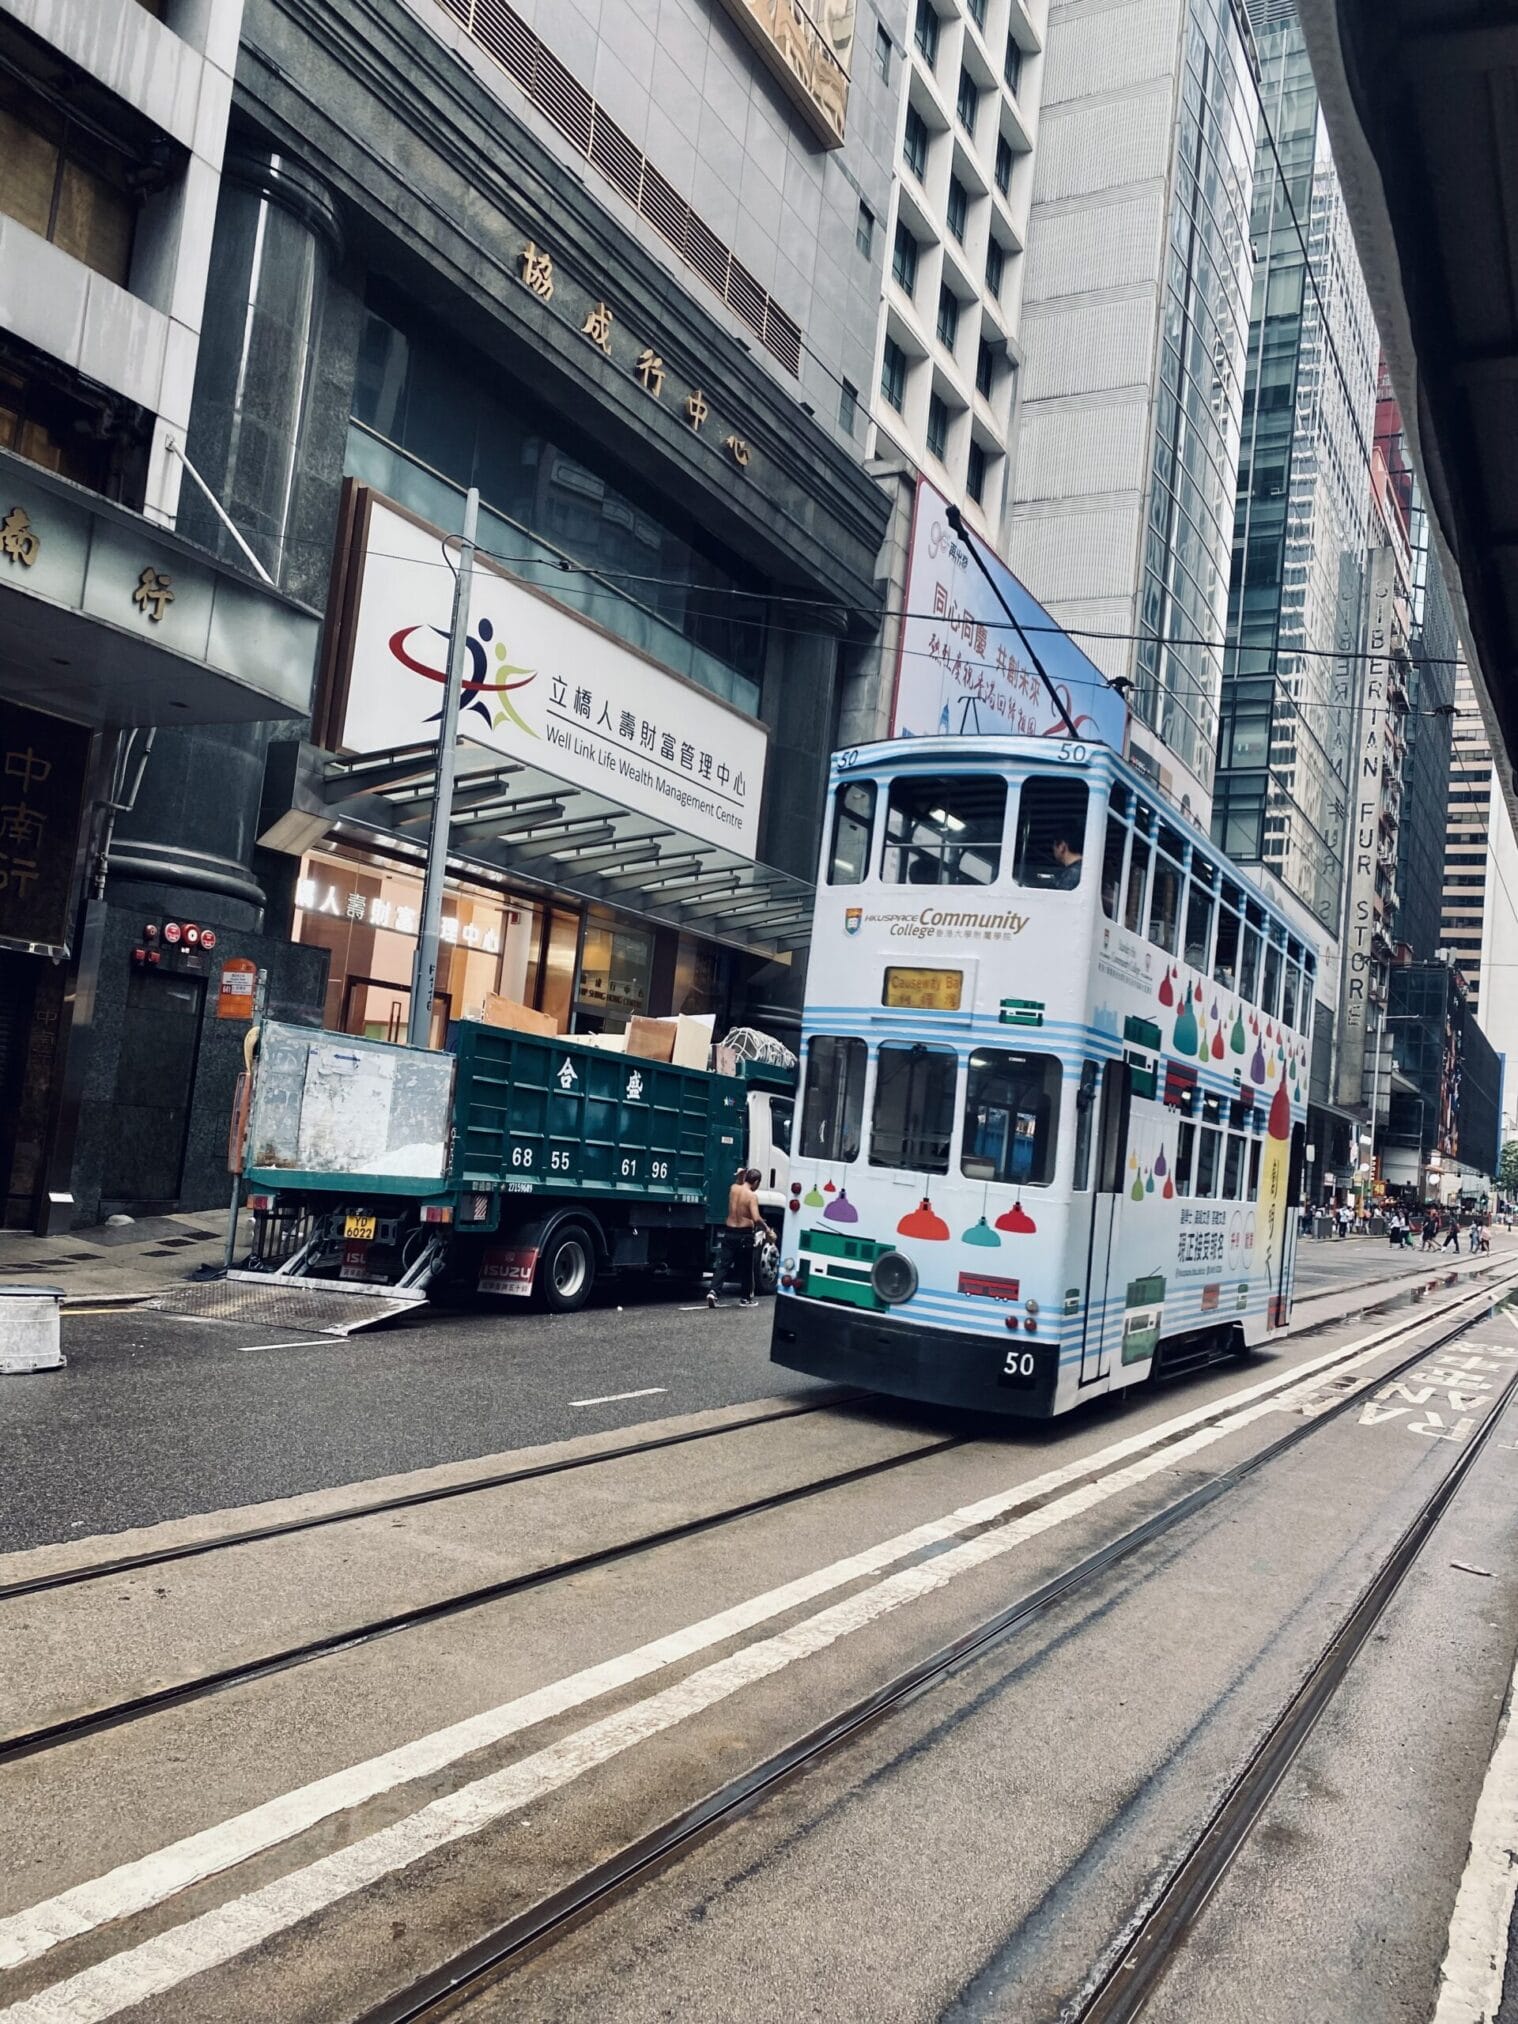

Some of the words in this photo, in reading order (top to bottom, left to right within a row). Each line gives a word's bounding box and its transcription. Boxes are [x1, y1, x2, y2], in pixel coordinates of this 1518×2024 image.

[520, 241, 749, 466] 協成行中心
[1363, 580, 1390, 778] SIBERIAN
[549, 675, 746, 797] 立橋人壽財富管理中心
[837, 750, 858, 769] 50
[1058, 743, 1086, 762] 50
[546, 723, 571, 750] Well
[573, 733, 596, 761] Link
[597, 746, 616, 771] Life
[618, 758, 653, 788] Wealth
[655, 776, 715, 817] Management
[715, 805, 743, 829] Centre
[1357, 802, 1376, 876] FUR
[890, 924, 935, 939] College
[919, 907, 1031, 934] Community
[1347, 900, 1369, 1027] STORE
[557, 1056, 643, 1100] 合盛
[511, 1147, 533, 1168] 68
[551, 1151, 570, 1170] 55
[621, 1158, 637, 1177] 61
[651, 1161, 668, 1180] 96
[346, 1226, 373, 1239] 6022
[355, 1216, 368, 1227] YD
[483, 1264, 533, 1279] ISUZU
[1003, 1352, 1034, 1376] 50
